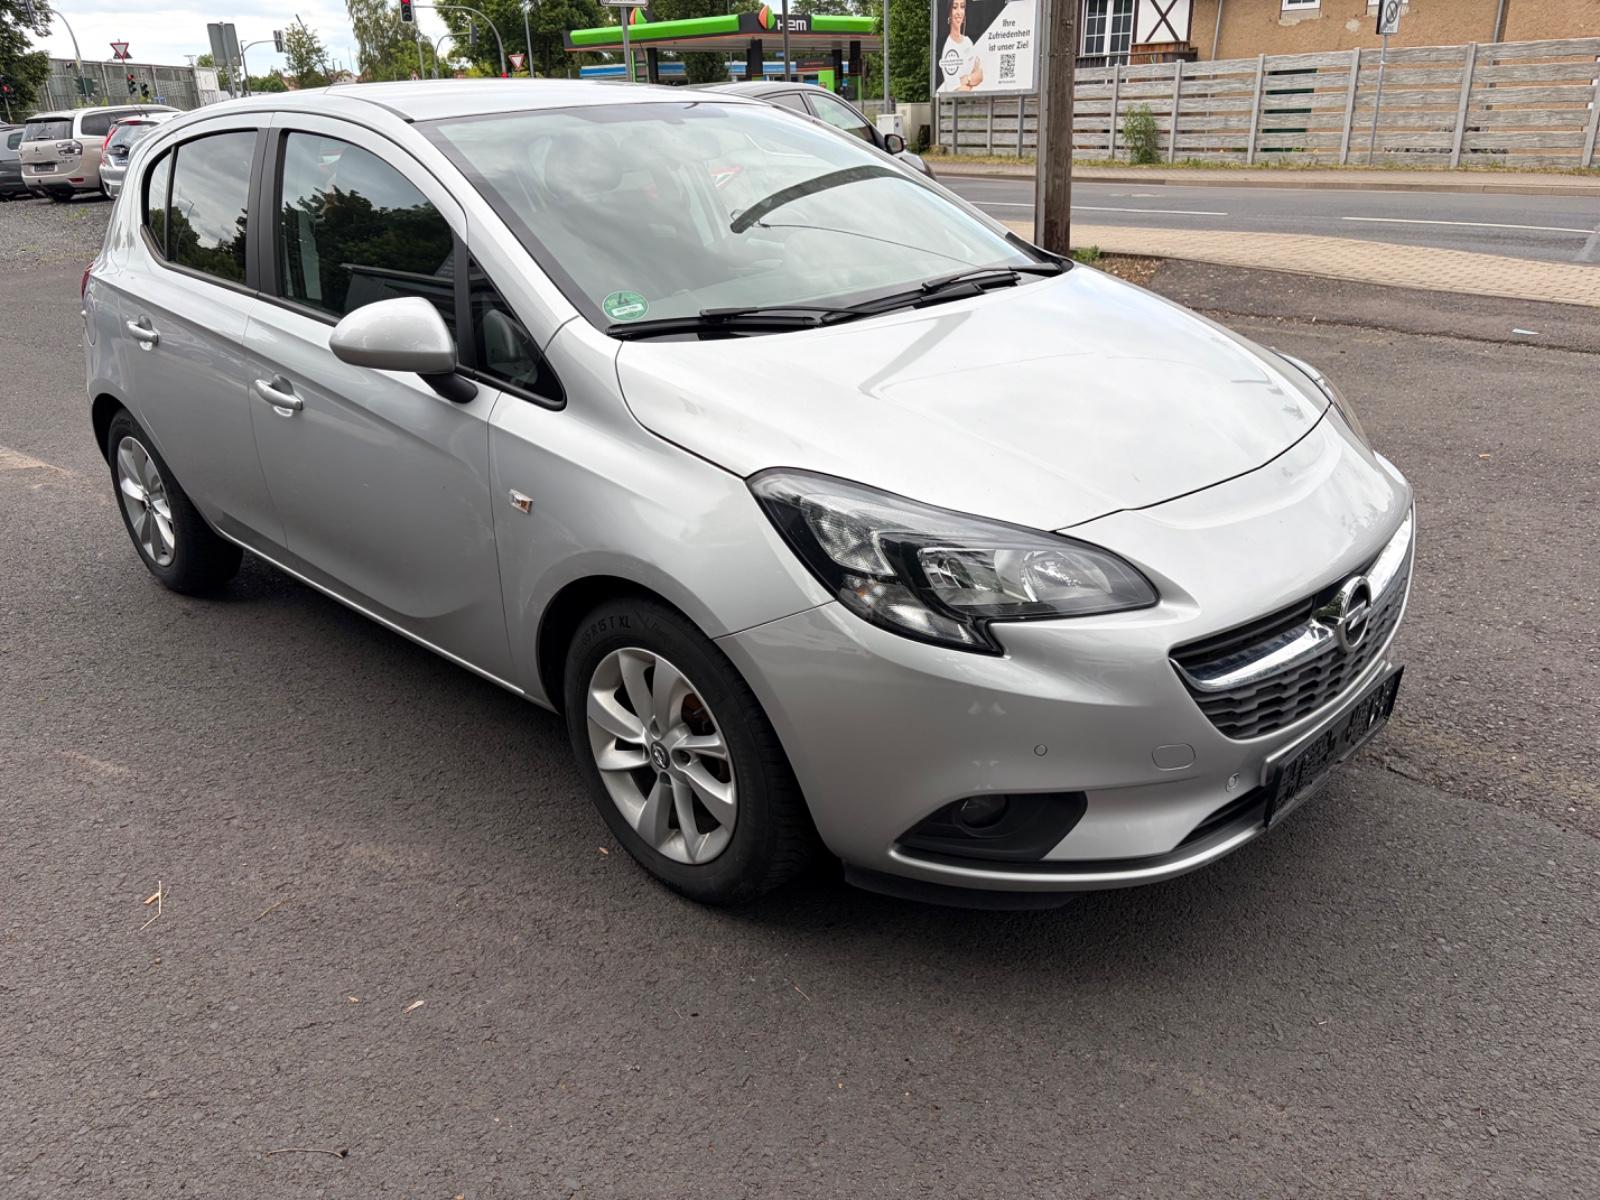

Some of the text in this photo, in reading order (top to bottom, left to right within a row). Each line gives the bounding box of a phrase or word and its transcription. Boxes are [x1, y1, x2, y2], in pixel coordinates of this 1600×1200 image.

[1002, 19, 1016, 27] Ihre
[988, 30, 1031, 40] Zufriedenheit
[988, 40, 1029, 52] ist unser Ziel
